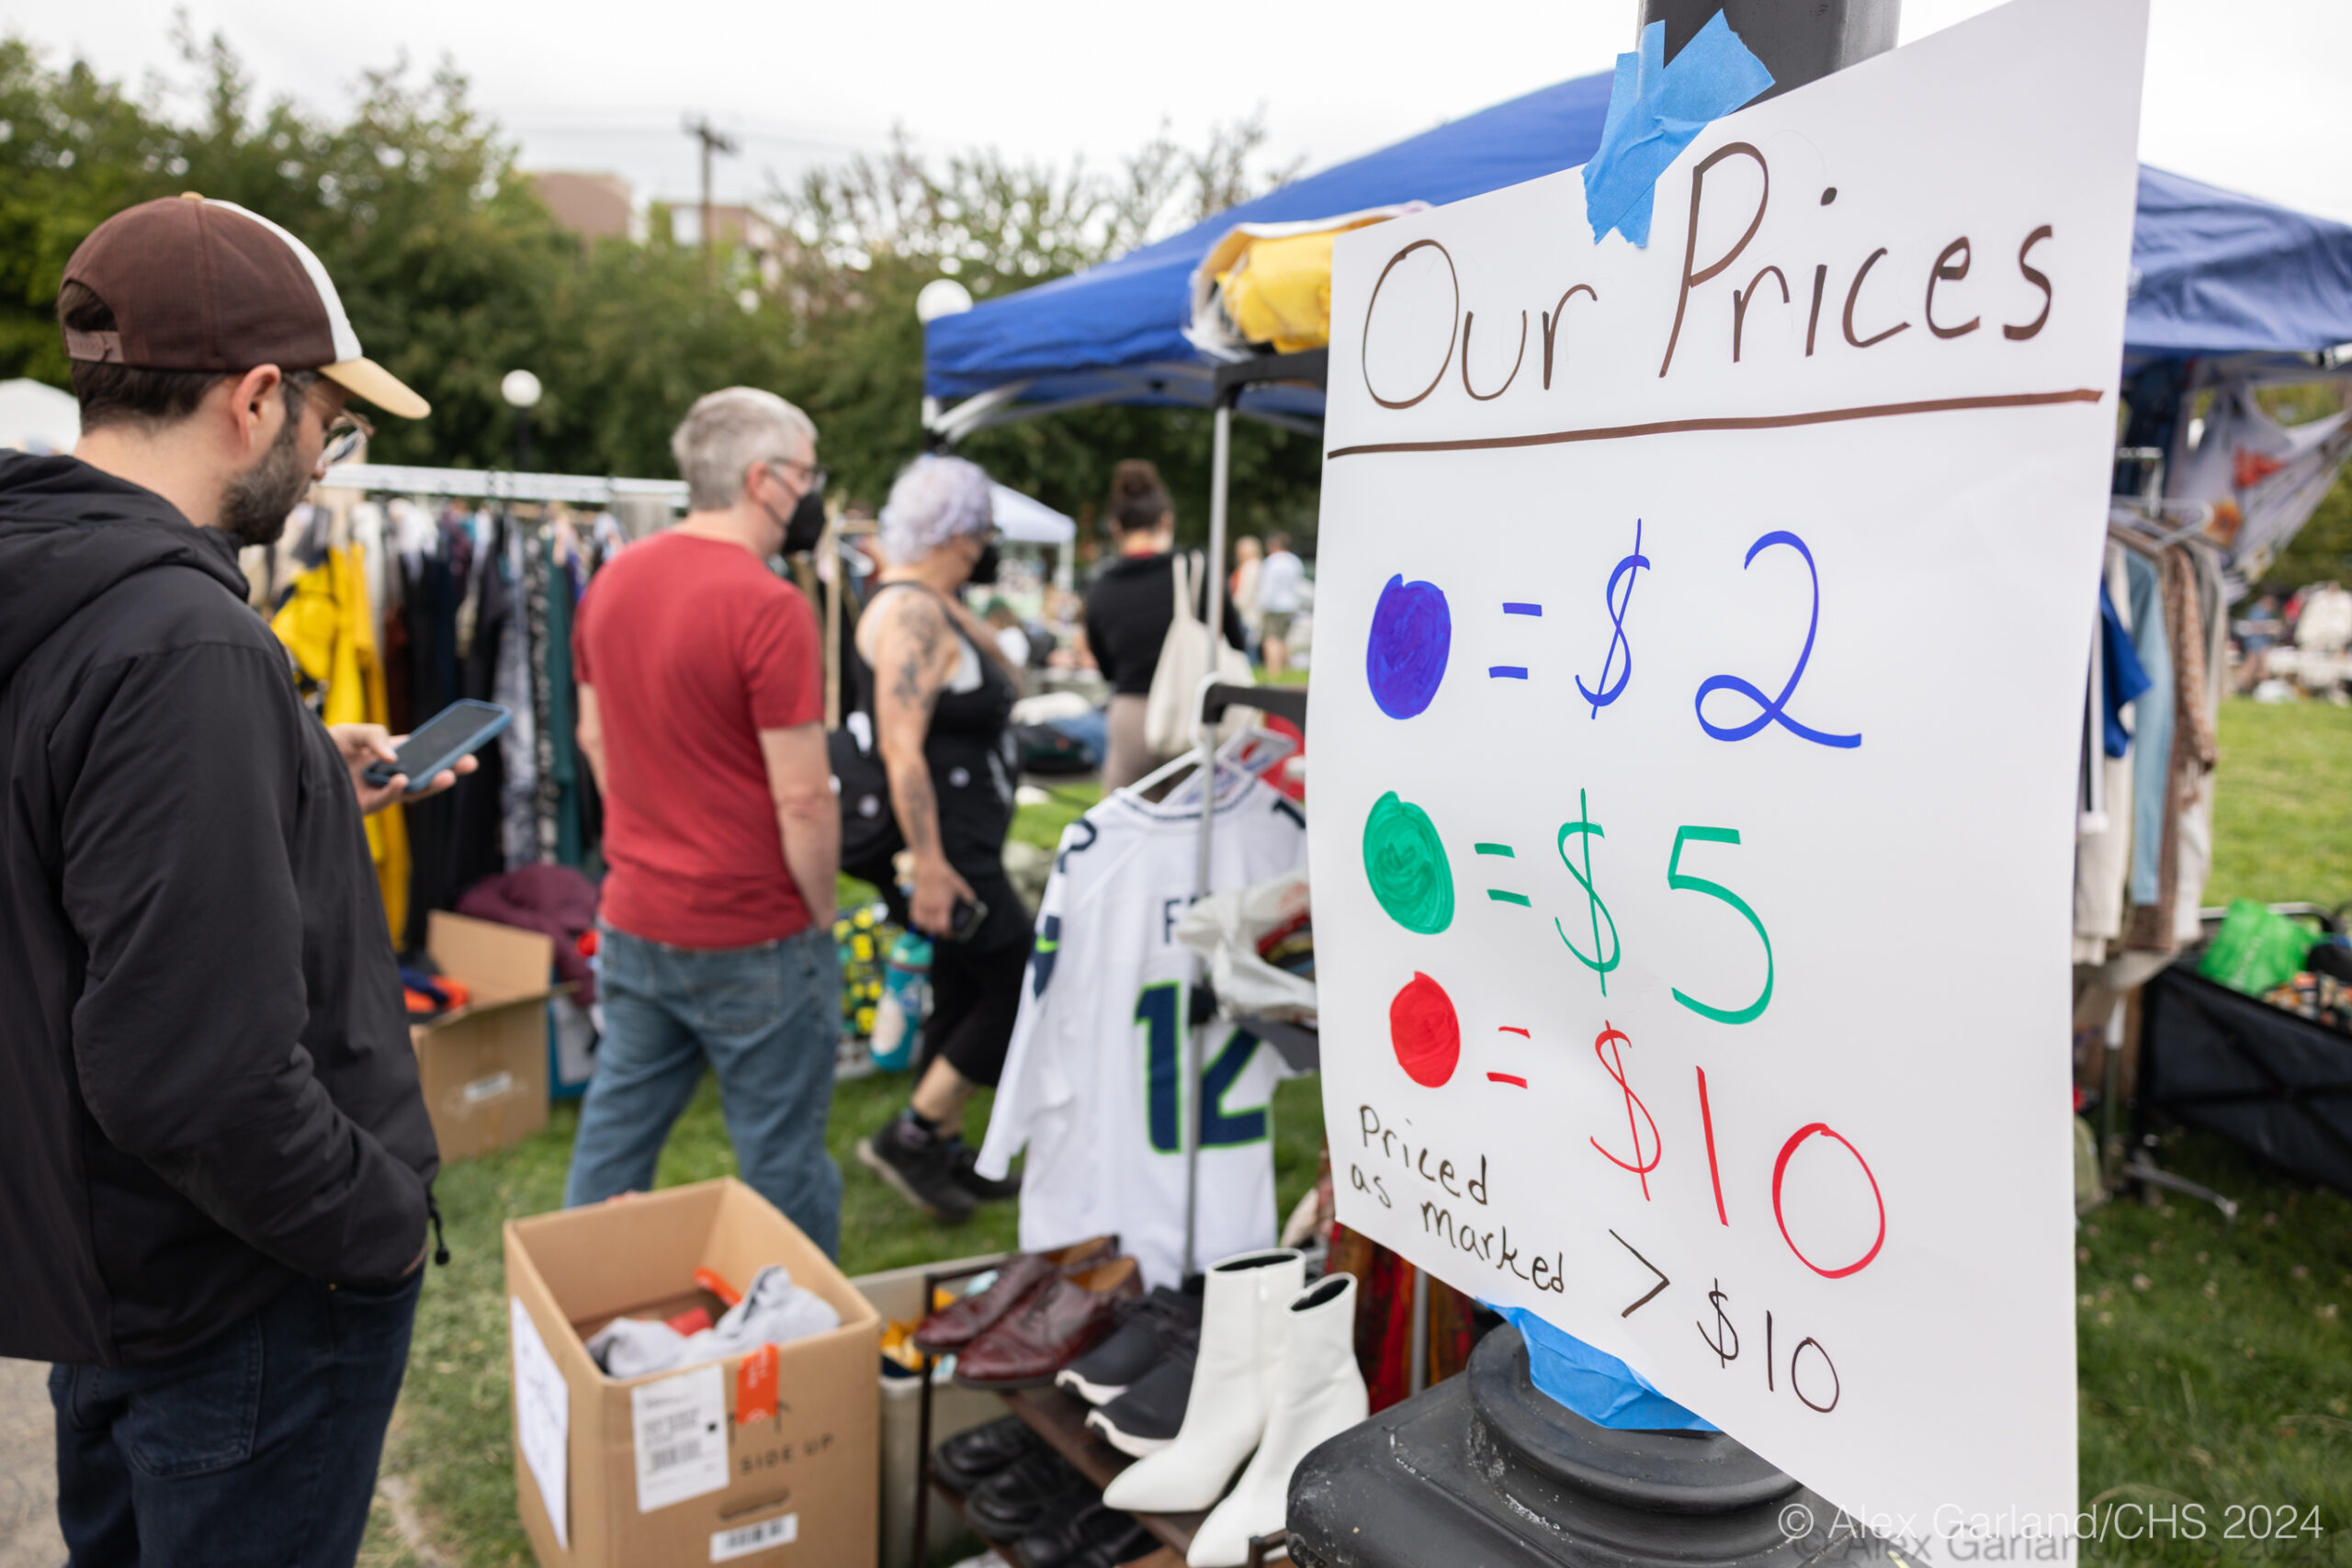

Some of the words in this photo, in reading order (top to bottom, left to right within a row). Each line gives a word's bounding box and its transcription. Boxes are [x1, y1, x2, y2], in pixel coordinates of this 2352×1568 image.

[1362, 238, 1599, 411] Our
[1657, 141, 2053, 379] Prices
[1359, 1104, 1488, 1206] Priced
[1351, 1163, 1392, 1209] as
[1696, 1277, 1840, 1414] $10
[741, 1442, 795, 1475] SIDE
[802, 1433, 834, 1457] UP
